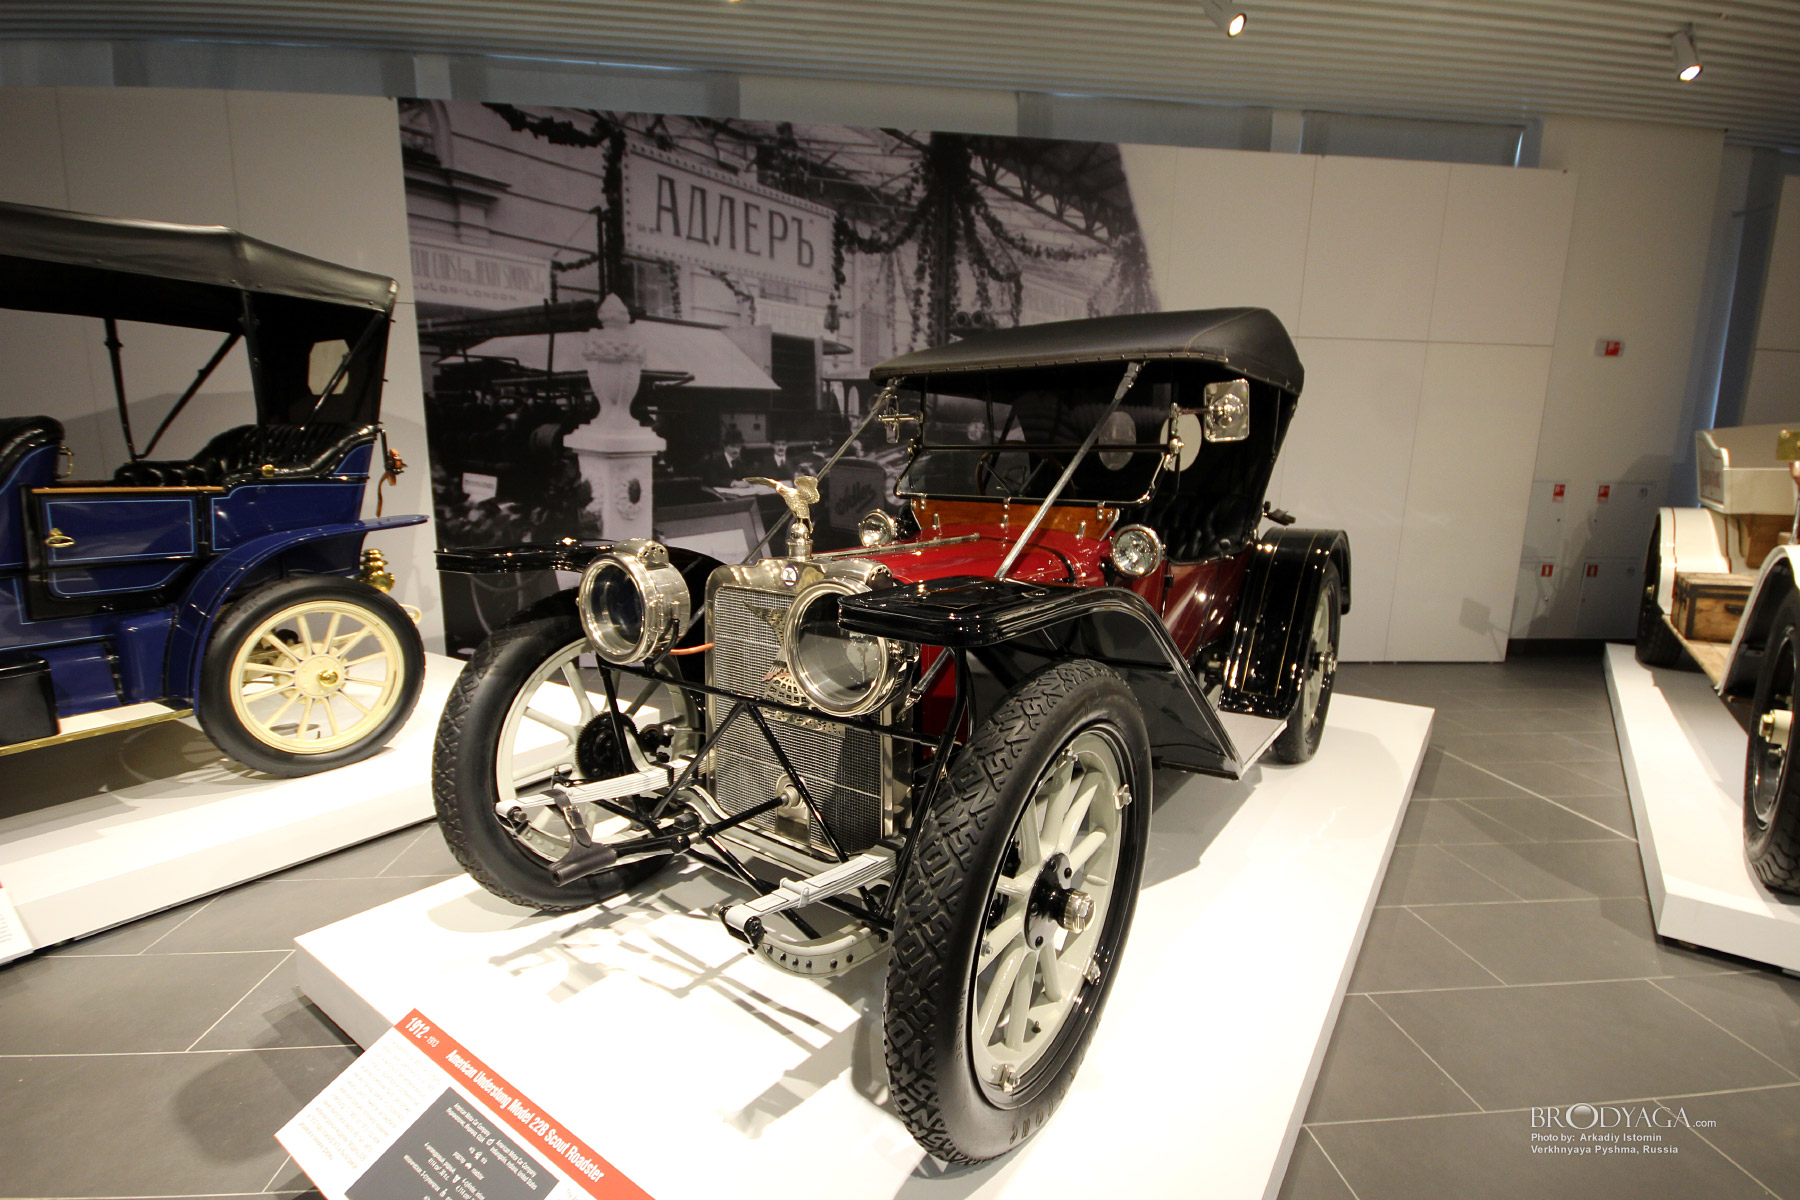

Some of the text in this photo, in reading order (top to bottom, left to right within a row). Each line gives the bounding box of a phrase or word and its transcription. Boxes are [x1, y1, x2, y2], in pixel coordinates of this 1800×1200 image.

[656, 173, 815, 269] АДЛЕРЪ
[405, 1017, 430, 1038] 1912
[426, 1036, 440, 1047] 1913
[445, 1049, 478, 1078] American
[473, 1071, 512, 1109] Underslung
[507, 1098, 536, 1124] Model
[528, 1117, 550, 1136] 22B
[544, 1128, 571, 1154] Scout
[564, 1145, 605, 1182] Roadster
[453, 1102, 467, 1115] American
[495, 1139, 511, 1154] American
[508, 1150, 519, 1161] Motor
[521, 1162, 537, 1178] Company
[517, 1170, 529, 1182] United
[526, 1178, 538, 1190] States
